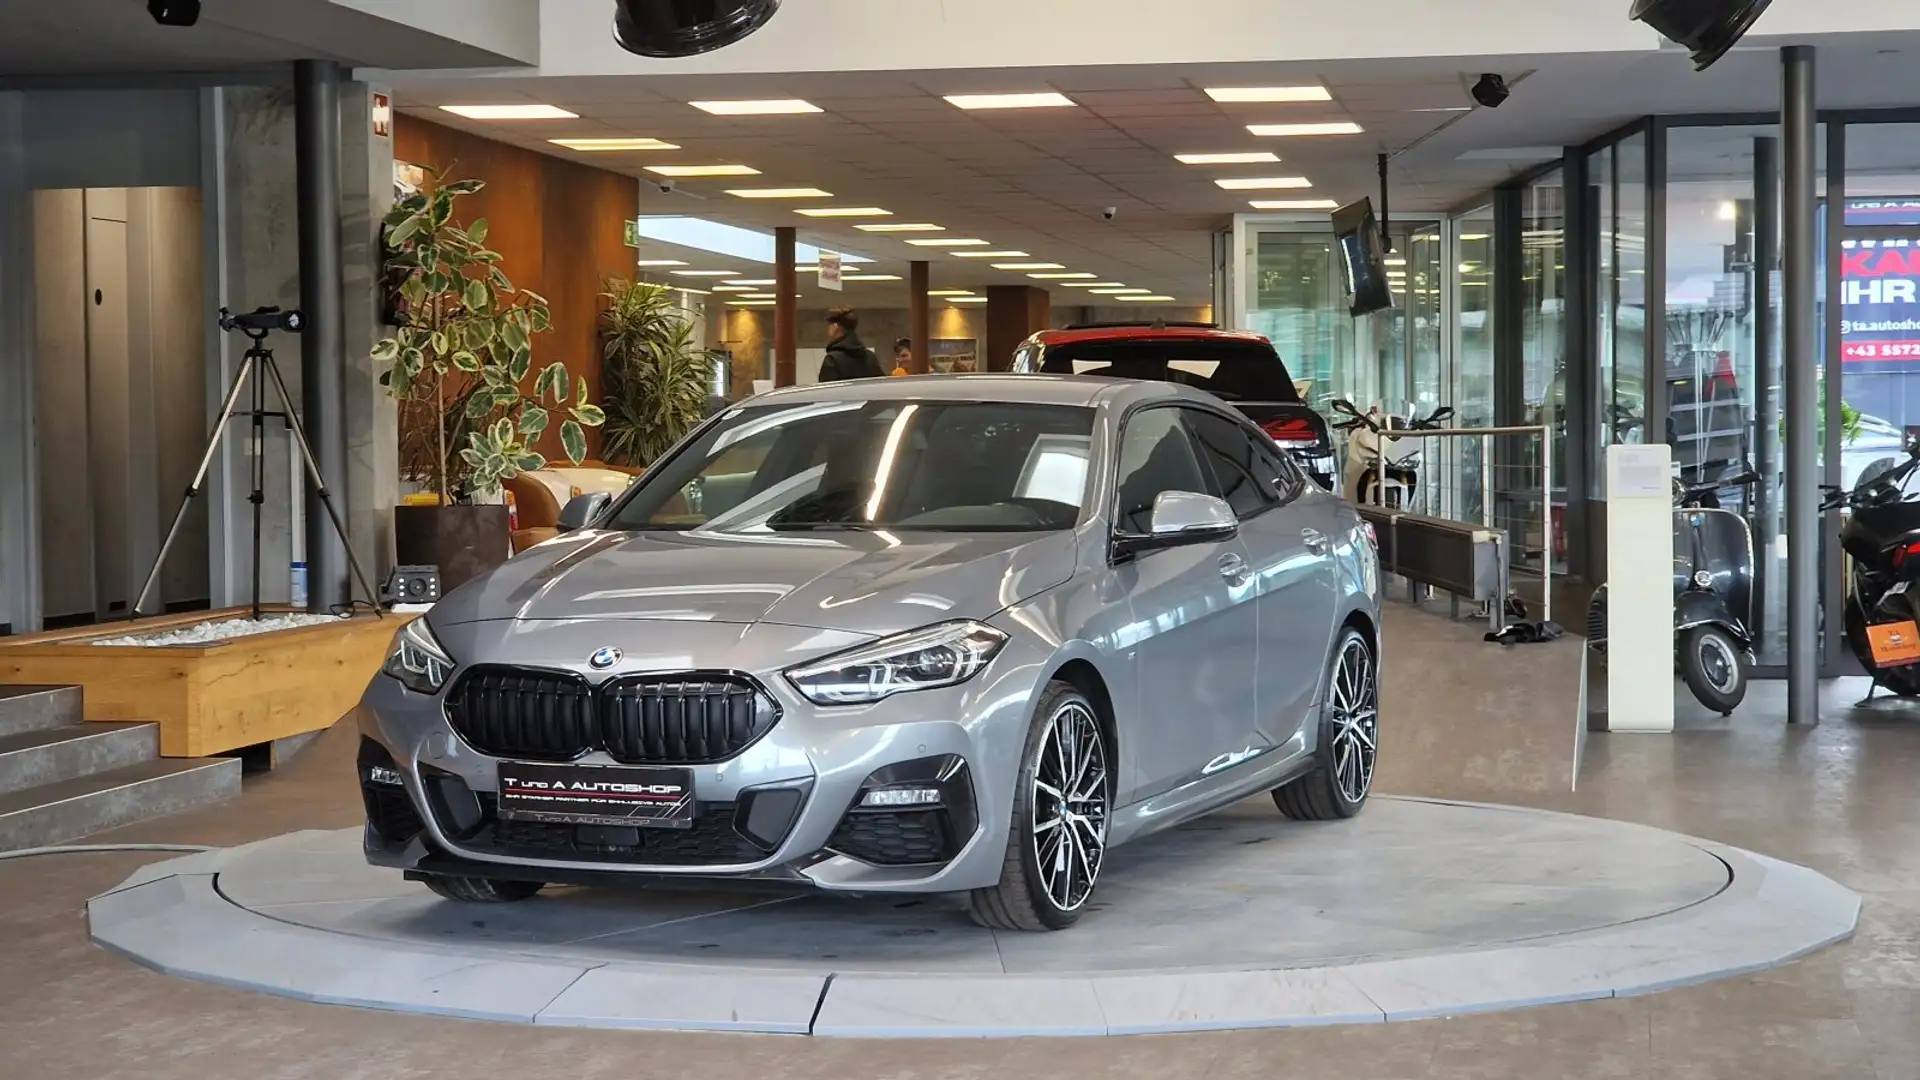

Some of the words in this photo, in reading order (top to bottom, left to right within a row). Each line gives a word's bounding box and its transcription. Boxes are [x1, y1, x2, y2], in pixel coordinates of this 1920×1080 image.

[1841, 279, 1916, 304] IHR
[1846, 344, 1876, 357] +43
[1880, 344, 1920, 356] 5572
[504, 777, 518, 787] T
[552, 780, 567, 790] A
[570, 781, 682, 794] AUTOSHOP
[534, 813, 545, 822] T
[562, 815, 572, 823] A
[576, 817, 650, 827] AUTOSHOP
